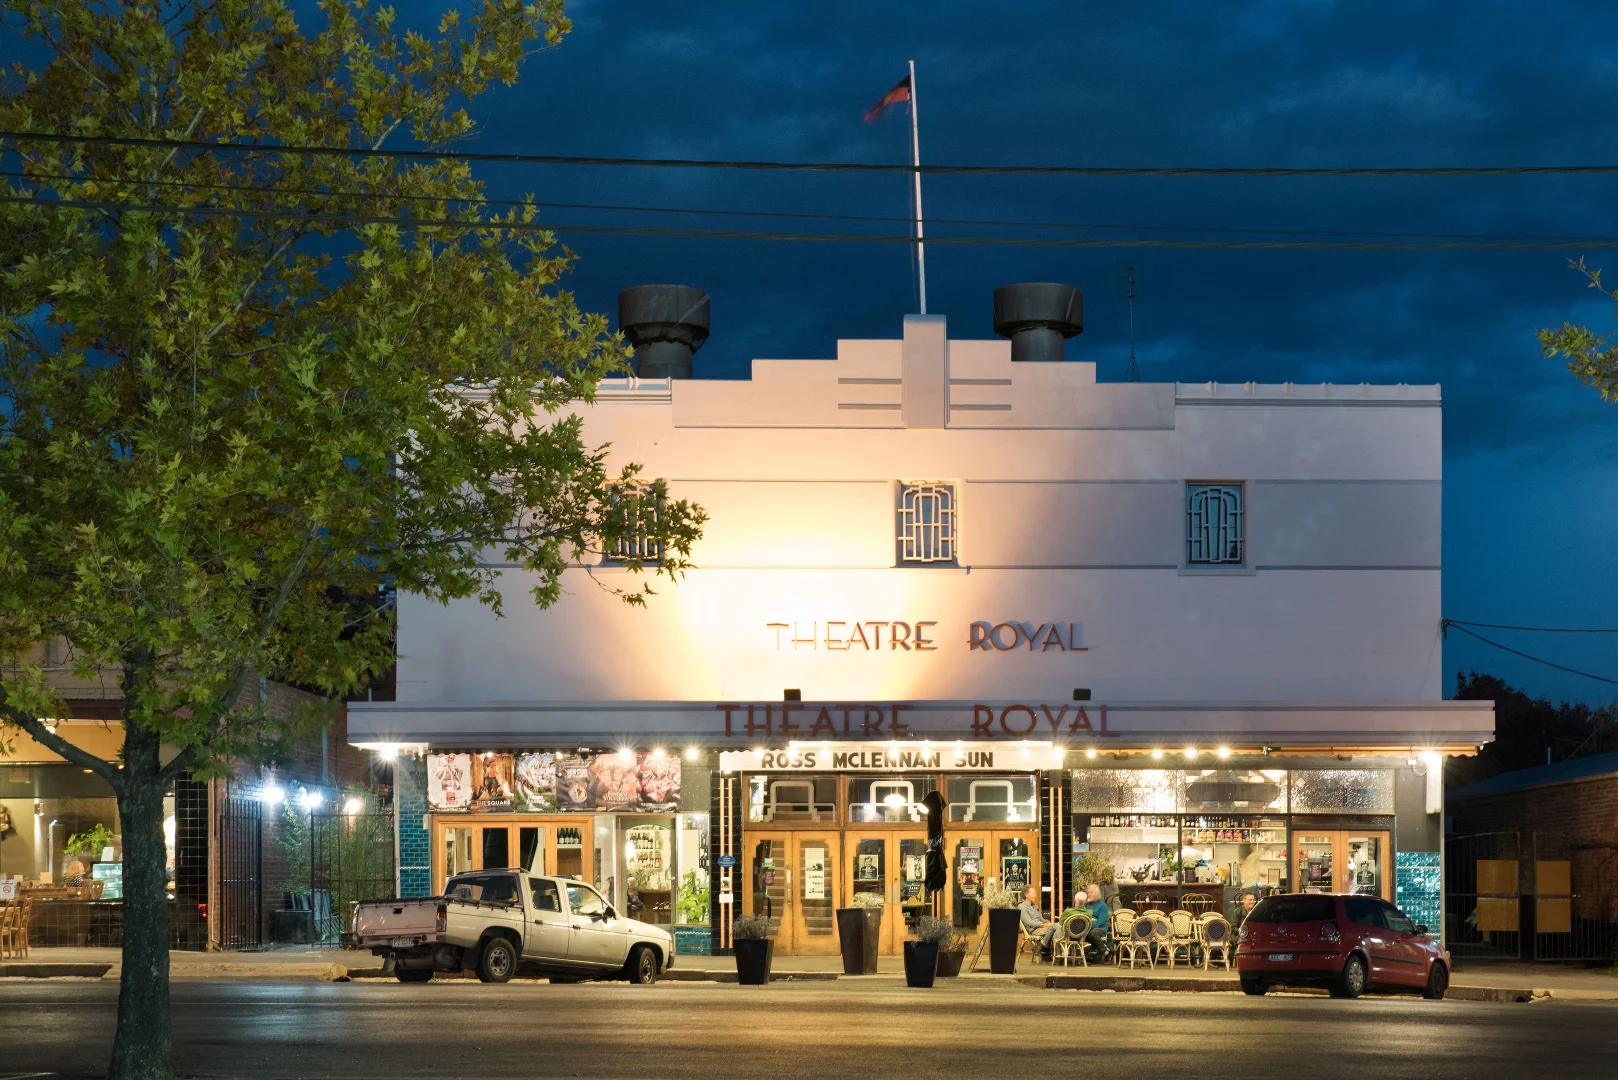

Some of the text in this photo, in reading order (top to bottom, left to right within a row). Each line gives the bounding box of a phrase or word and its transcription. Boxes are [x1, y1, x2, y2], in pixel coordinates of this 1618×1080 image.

[766, 621, 1089, 652] THEATRE ROYAL
[716, 704, 1121, 738] THEATRE ROYAL
[761, 752, 994, 769] ROSS MCLENNAN SUN
